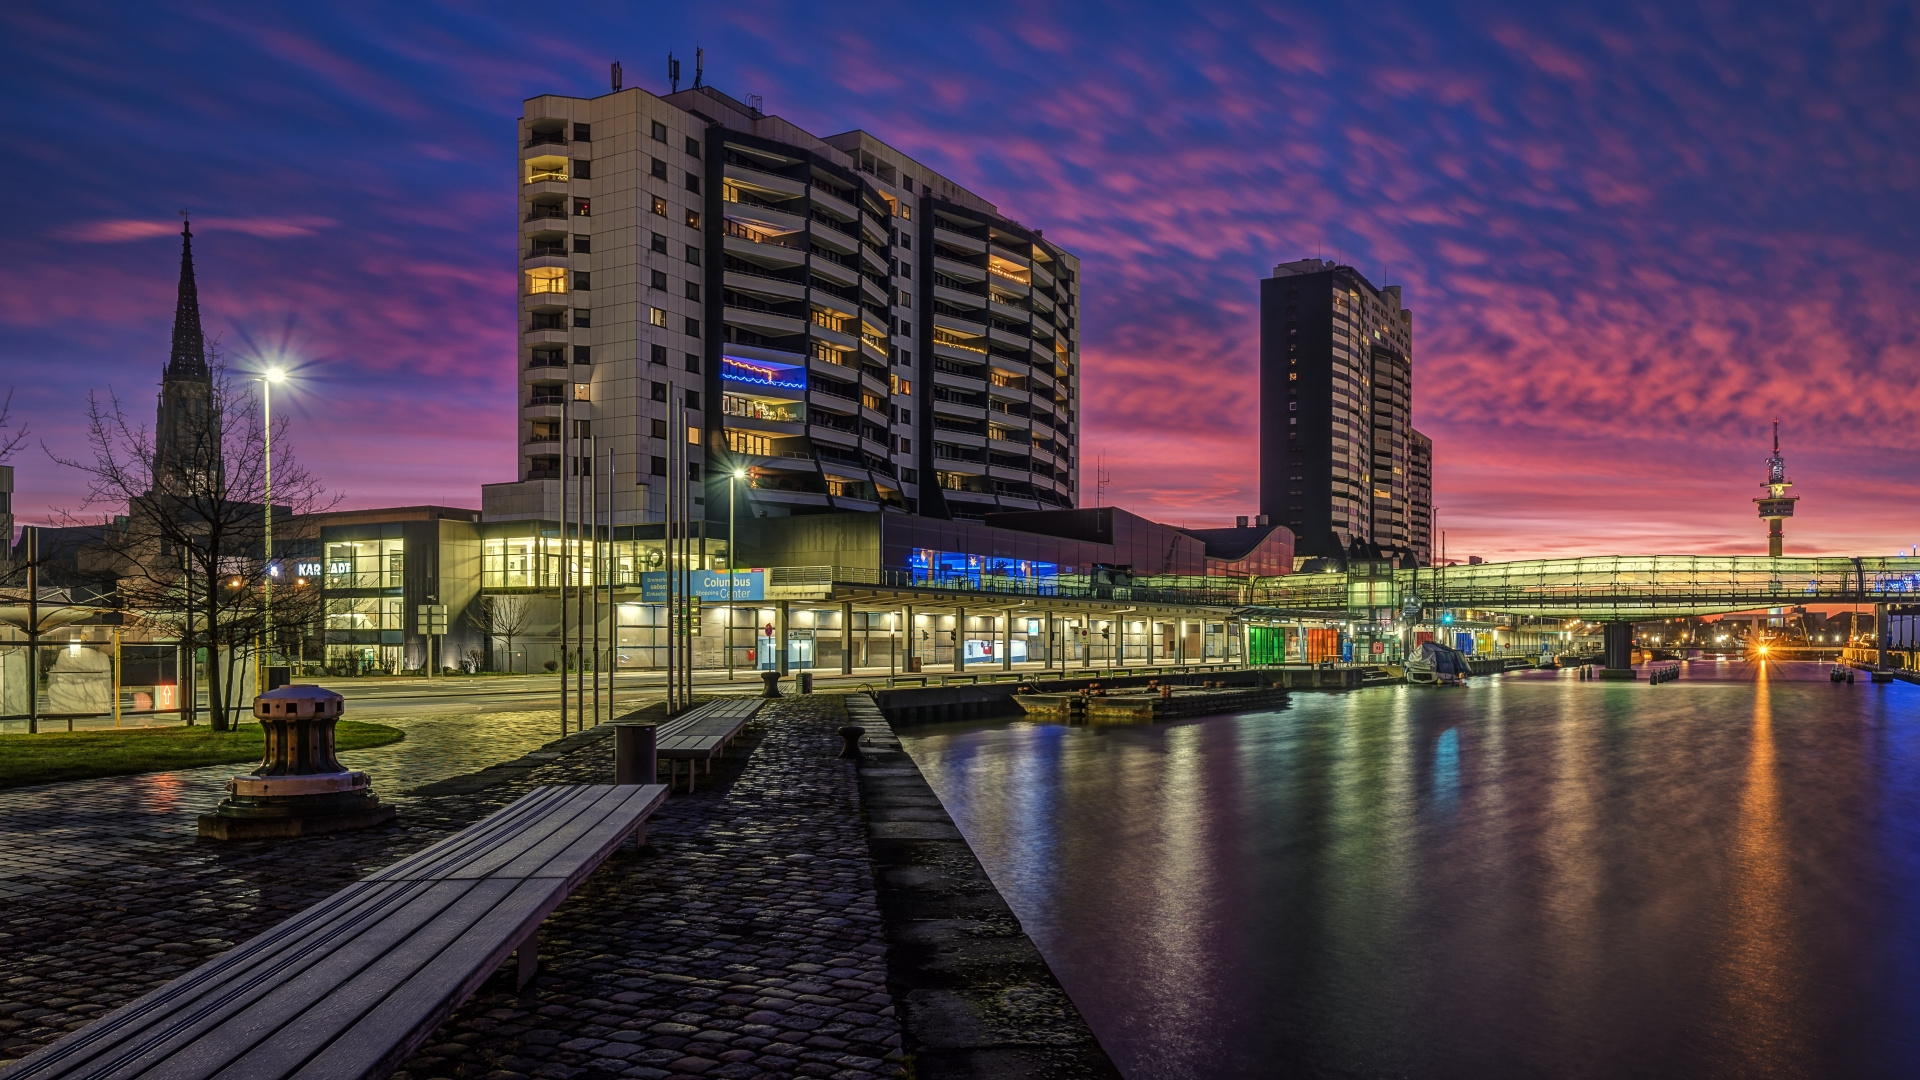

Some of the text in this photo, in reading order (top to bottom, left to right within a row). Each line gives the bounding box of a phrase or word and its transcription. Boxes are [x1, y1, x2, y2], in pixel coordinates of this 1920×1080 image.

[298, 563, 352, 576] KARADT
[704, 577, 751, 588] Columbus
[695, 588, 751, 599] Shopping Center
